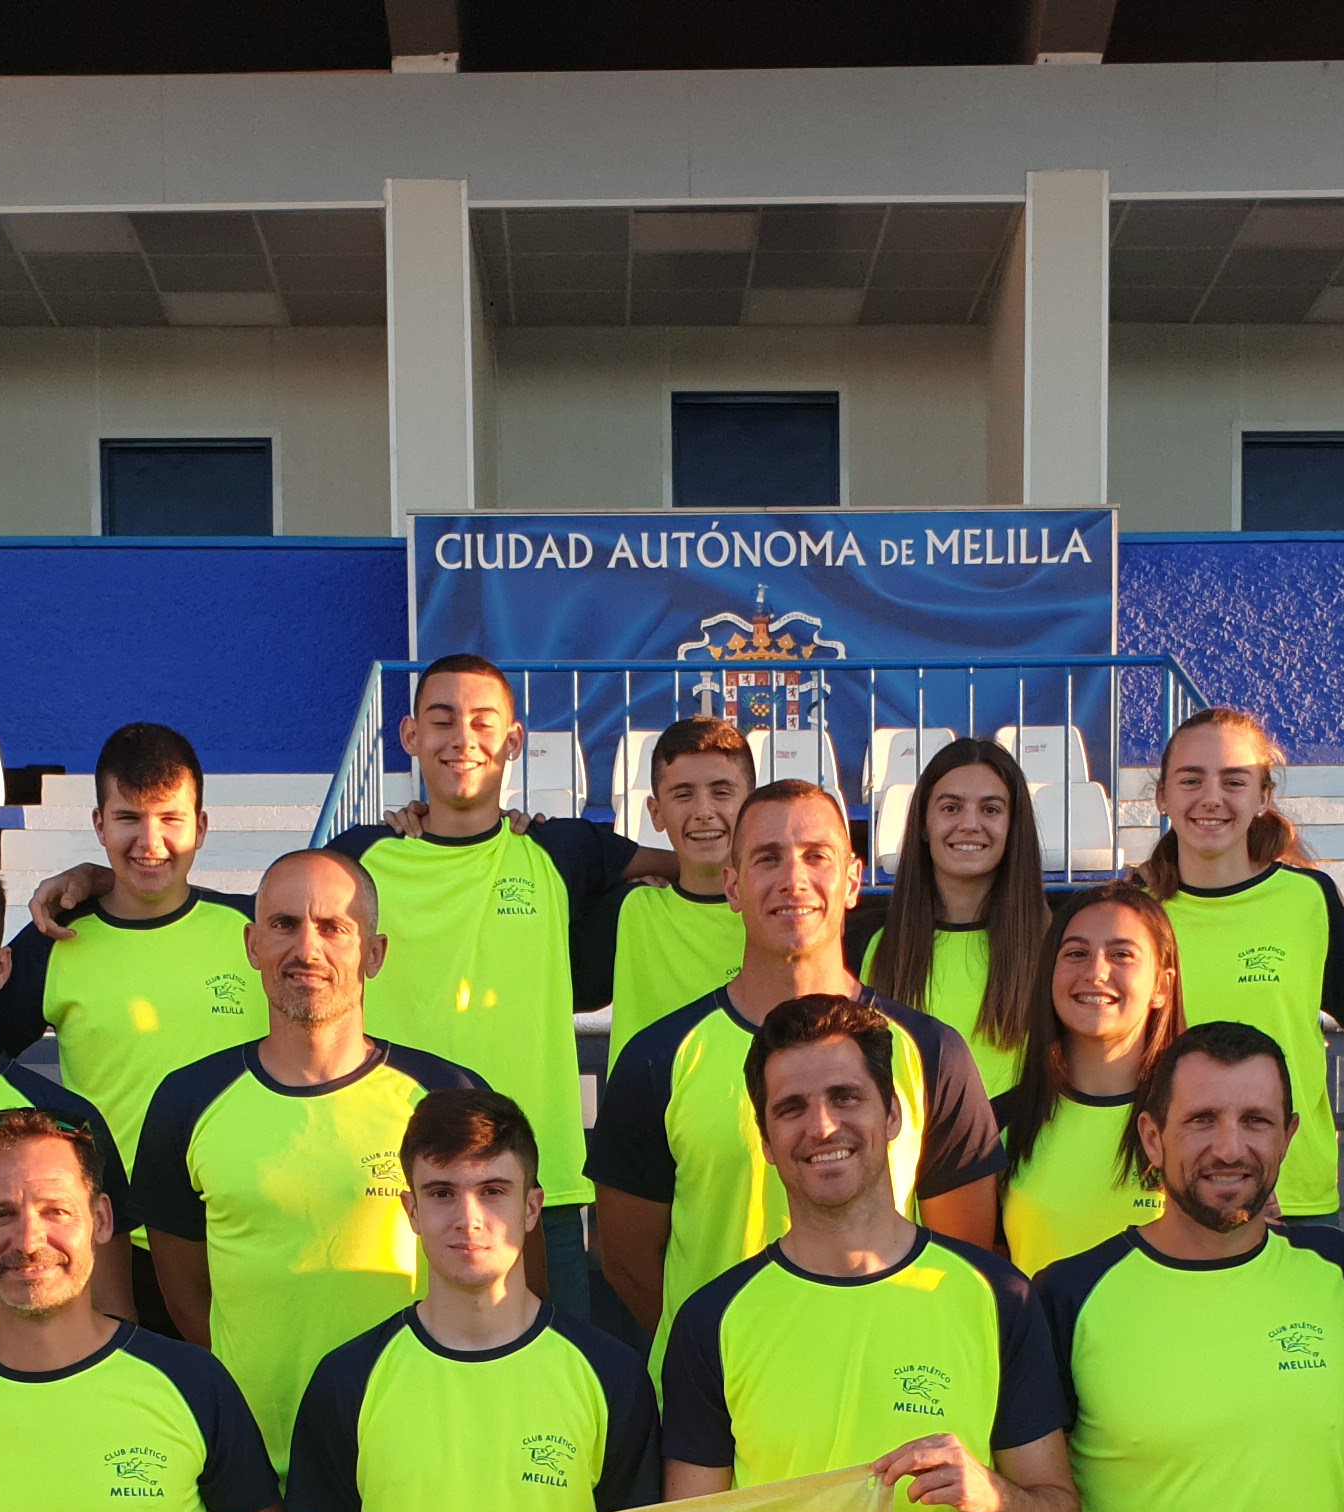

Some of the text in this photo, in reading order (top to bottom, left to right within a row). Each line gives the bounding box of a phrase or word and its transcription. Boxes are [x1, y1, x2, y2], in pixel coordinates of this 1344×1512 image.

[435, 532, 594, 570] CIUDAD
[607, 522, 864, 569] AUTÓNOMA
[925, 528, 1092, 566] MELILLA
[497, 907, 537, 915] MELILLA
[1238, 974, 1280, 983] MELILLA
[211, 1006, 244, 1014] MELILLA
[361, 1152, 381, 1164] CLUB
[365, 1187, 401, 1196] MELIL
[1268, 1325, 1287, 1338] CLUB
[1278, 1359, 1327, 1370] MELILLA
[894, 1365, 914, 1375] CLUB
[893, 1402, 945, 1417] MELILLA
[522, 1435, 543, 1445] CLUB
[104, 1448, 126, 1461] CLUB
[522, 1471, 568, 1488] MELILLA
[110, 1487, 164, 1497] MELILLA
